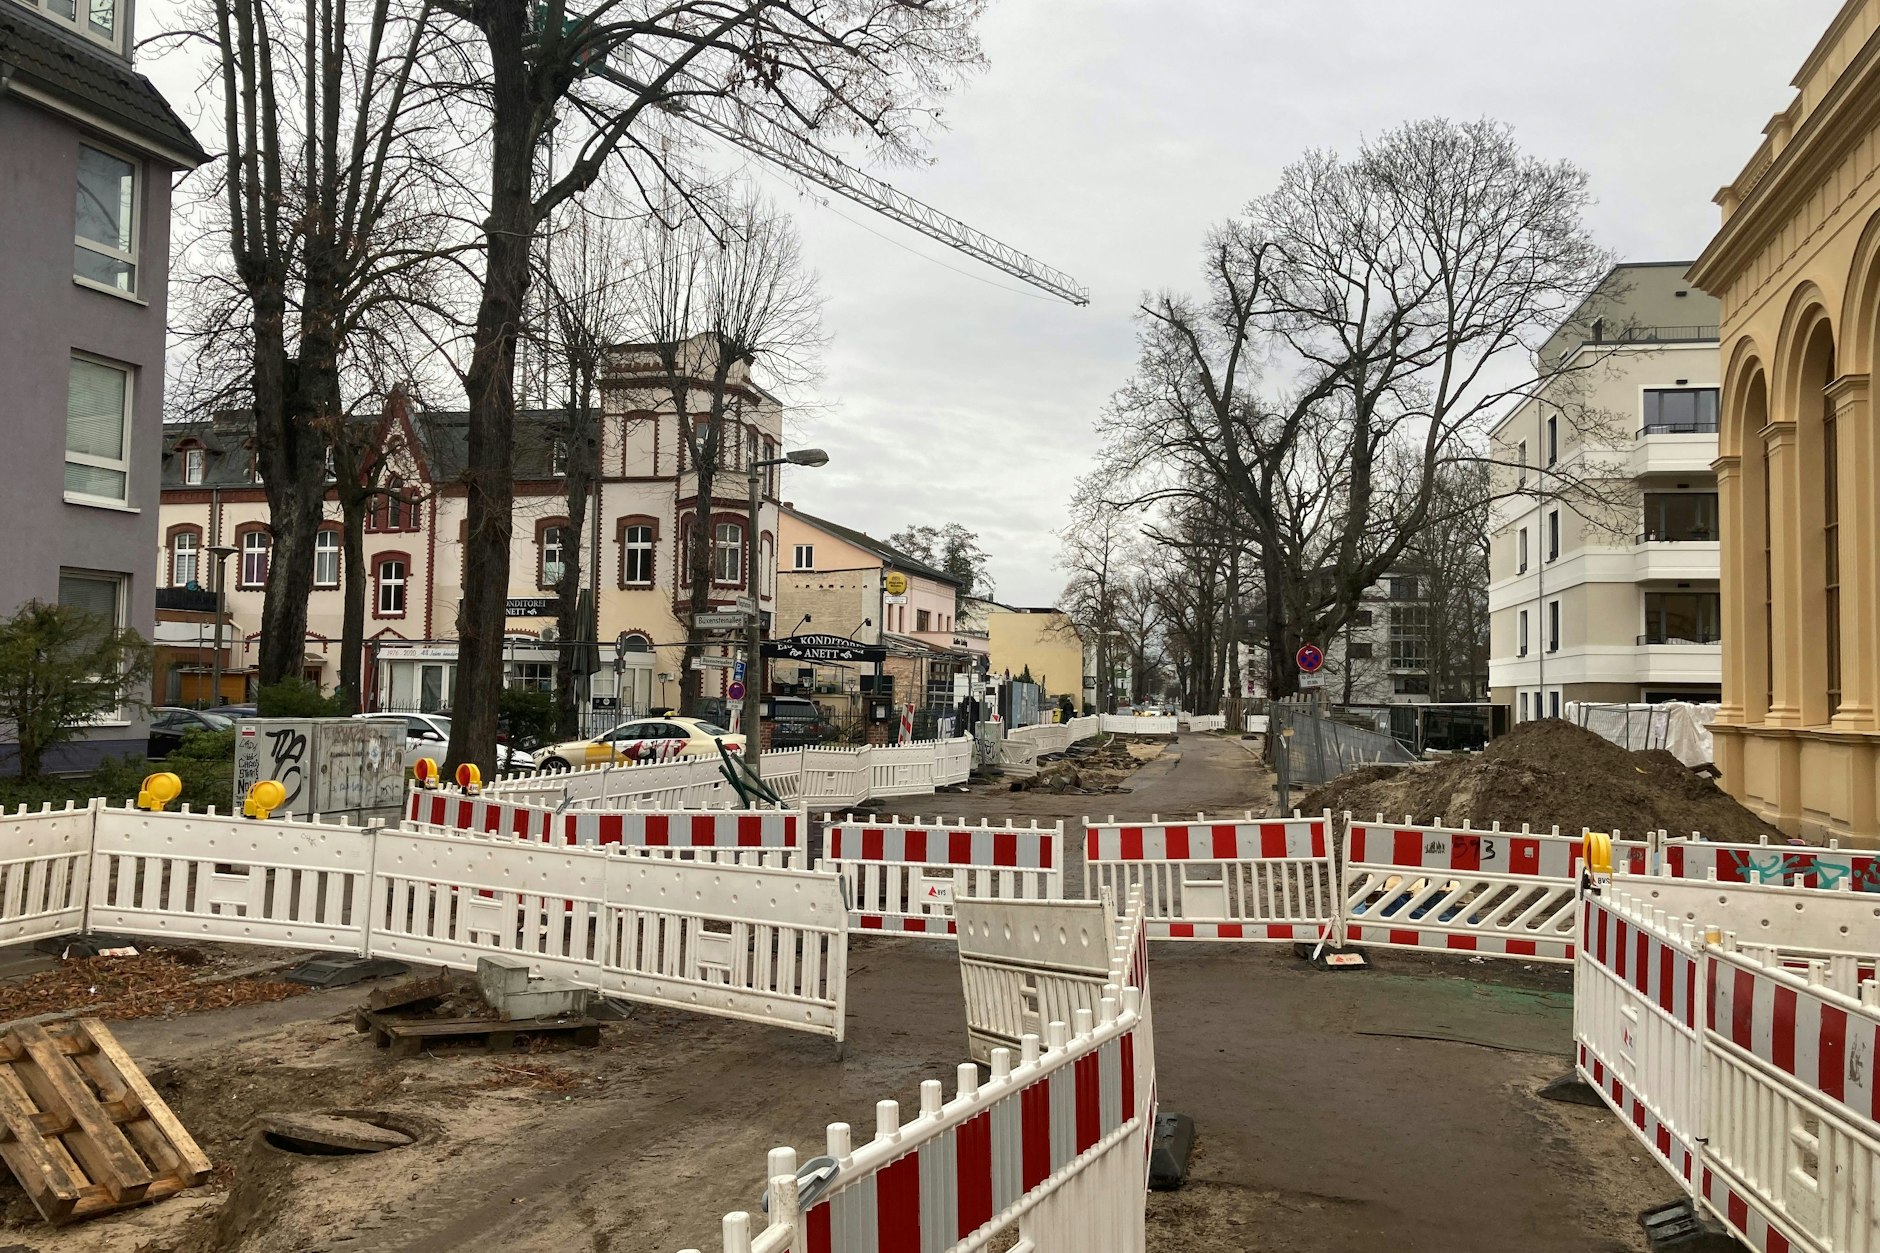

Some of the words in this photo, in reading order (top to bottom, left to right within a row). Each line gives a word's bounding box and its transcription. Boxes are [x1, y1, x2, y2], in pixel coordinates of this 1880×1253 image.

[506, 600, 546, 608] NDITOREI
[505, 608, 526, 616] NETT
[698, 616, 742, 625] Büxensteinallee
[804, 648, 839, 659] ANETT
